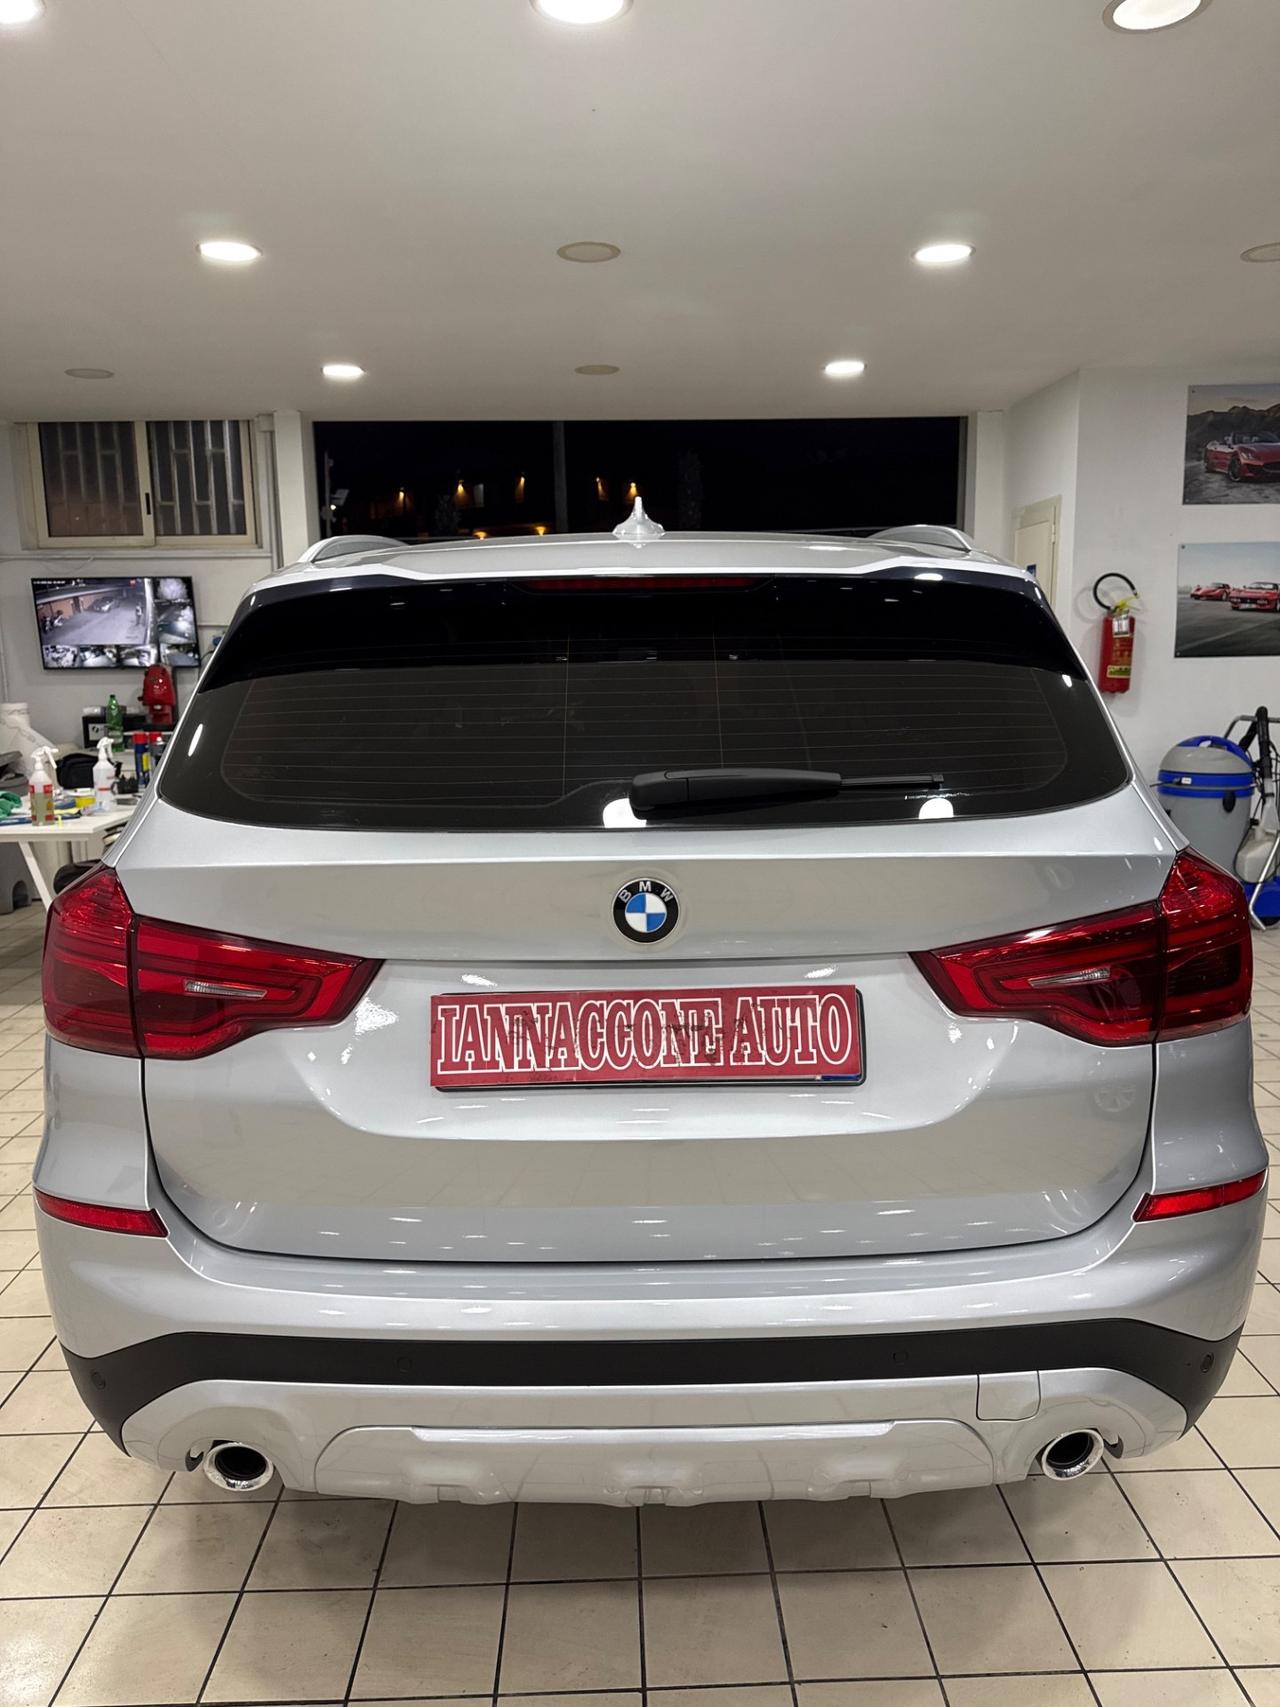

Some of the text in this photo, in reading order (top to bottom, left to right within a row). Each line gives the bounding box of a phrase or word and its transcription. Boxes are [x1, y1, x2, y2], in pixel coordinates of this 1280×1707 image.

[618, 881, 674, 903] BMW
[437, 993, 852, 1075] IANNACCONE AUTO
